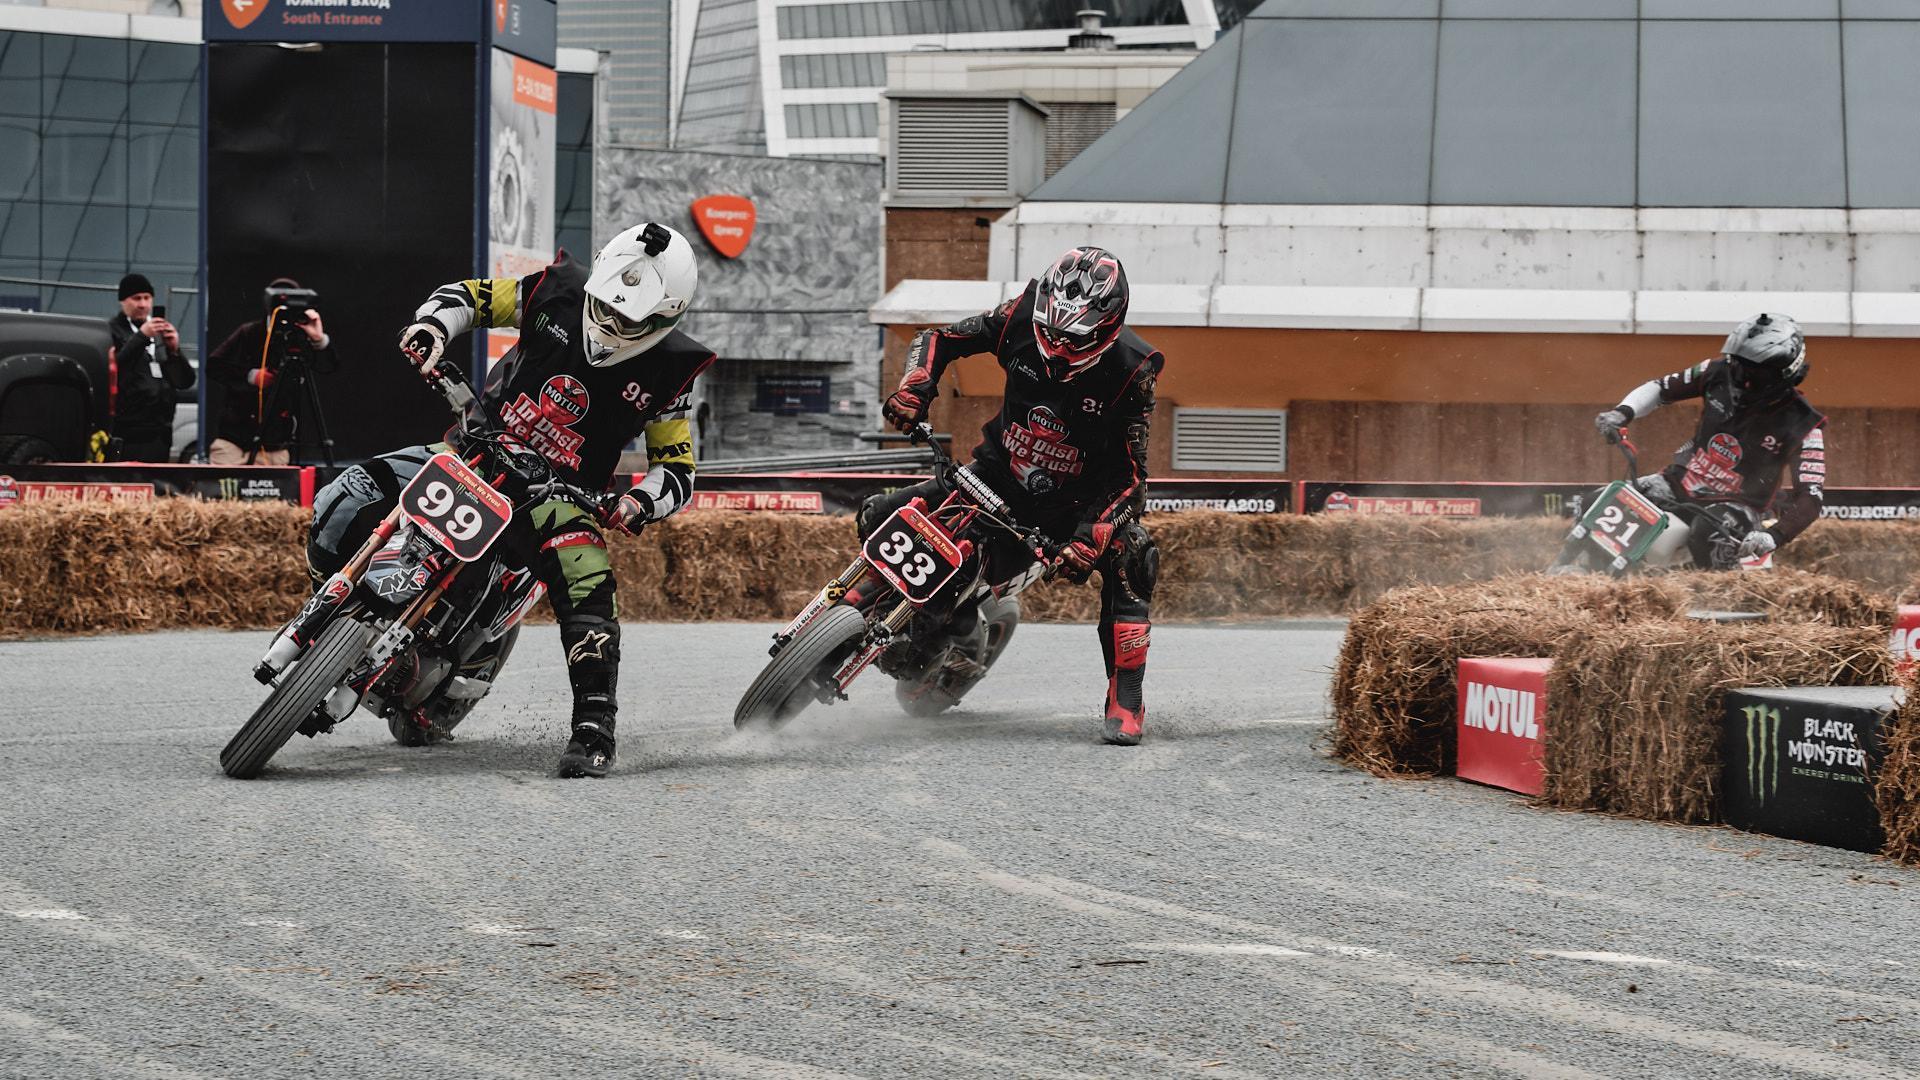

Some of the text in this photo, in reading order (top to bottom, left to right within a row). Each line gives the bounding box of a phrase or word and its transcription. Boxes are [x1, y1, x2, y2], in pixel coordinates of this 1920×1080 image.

[283, 11, 383, 26] South Entrance
[545, 385, 581, 416] MOTUL
[503, 407, 528, 436] We
[515, 399, 582, 452] In Dust
[1031, 412, 1066, 434] MOTUL
[1004, 435, 1077, 474] We Trust
[1013, 427, 1076, 461] In Dust
[43, 486, 78, 502] Dust
[82, 486, 108, 502] We
[110, 486, 149, 503] Trust
[698, 494, 817, 509] In Dust We Trust
[1411, 500, 1433, 515] We
[1437, 500, 1475, 515] Trust
[417, 481, 483, 541] 99
[424, 521, 447, 543] MOTUL
[1595, 506, 1640, 547] 21
[879, 531, 936, 586] 33
[1464, 681, 1539, 740] MOTUL
[1804, 717, 1856, 743] BLACK
[1788, 738, 1867, 767] MONSTER
[1792, 766, 1865, 784] ENERGY DRINK
